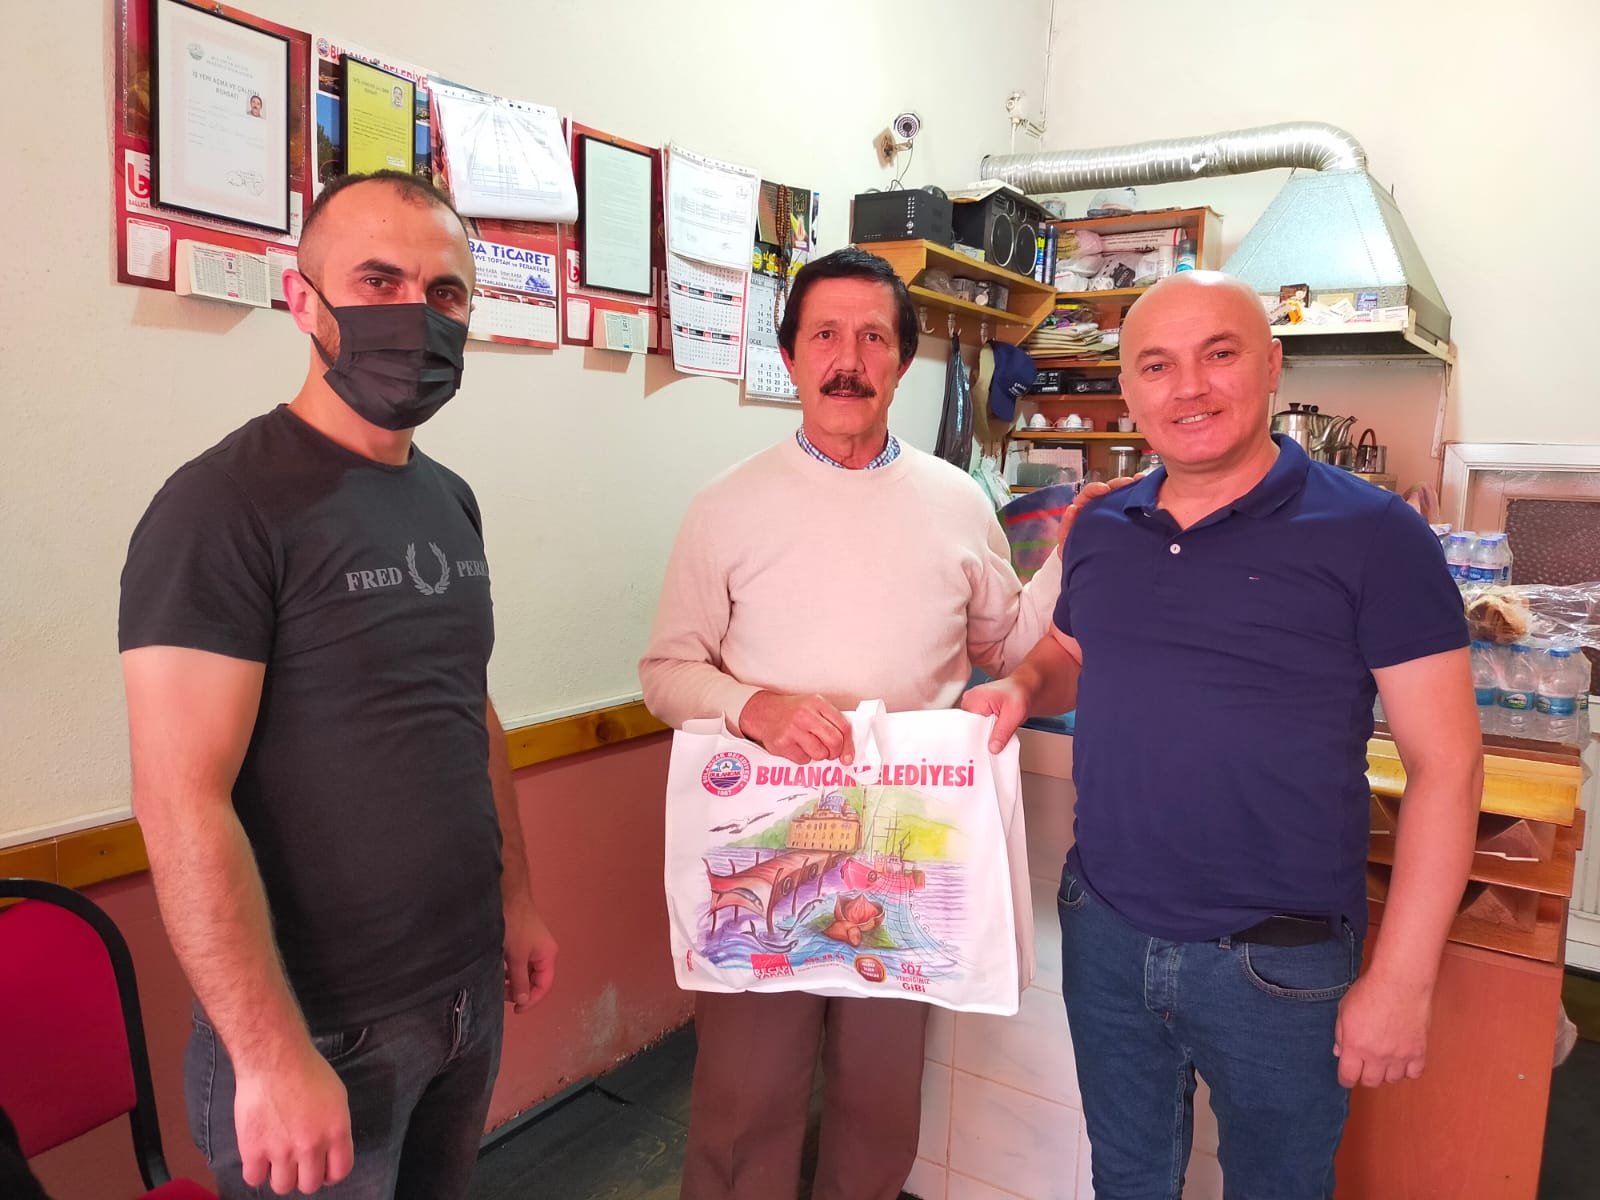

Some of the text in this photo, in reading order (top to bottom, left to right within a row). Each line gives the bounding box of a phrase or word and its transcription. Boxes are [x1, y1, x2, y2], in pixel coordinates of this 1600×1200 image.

[491, 245, 550, 267] TİCARET
[519, 263, 550, 273] PERAKENDE
[344, 566, 404, 592] FRED
[900, 960, 923, 977] SÖZ
[902, 982, 926, 993] GİBİ
